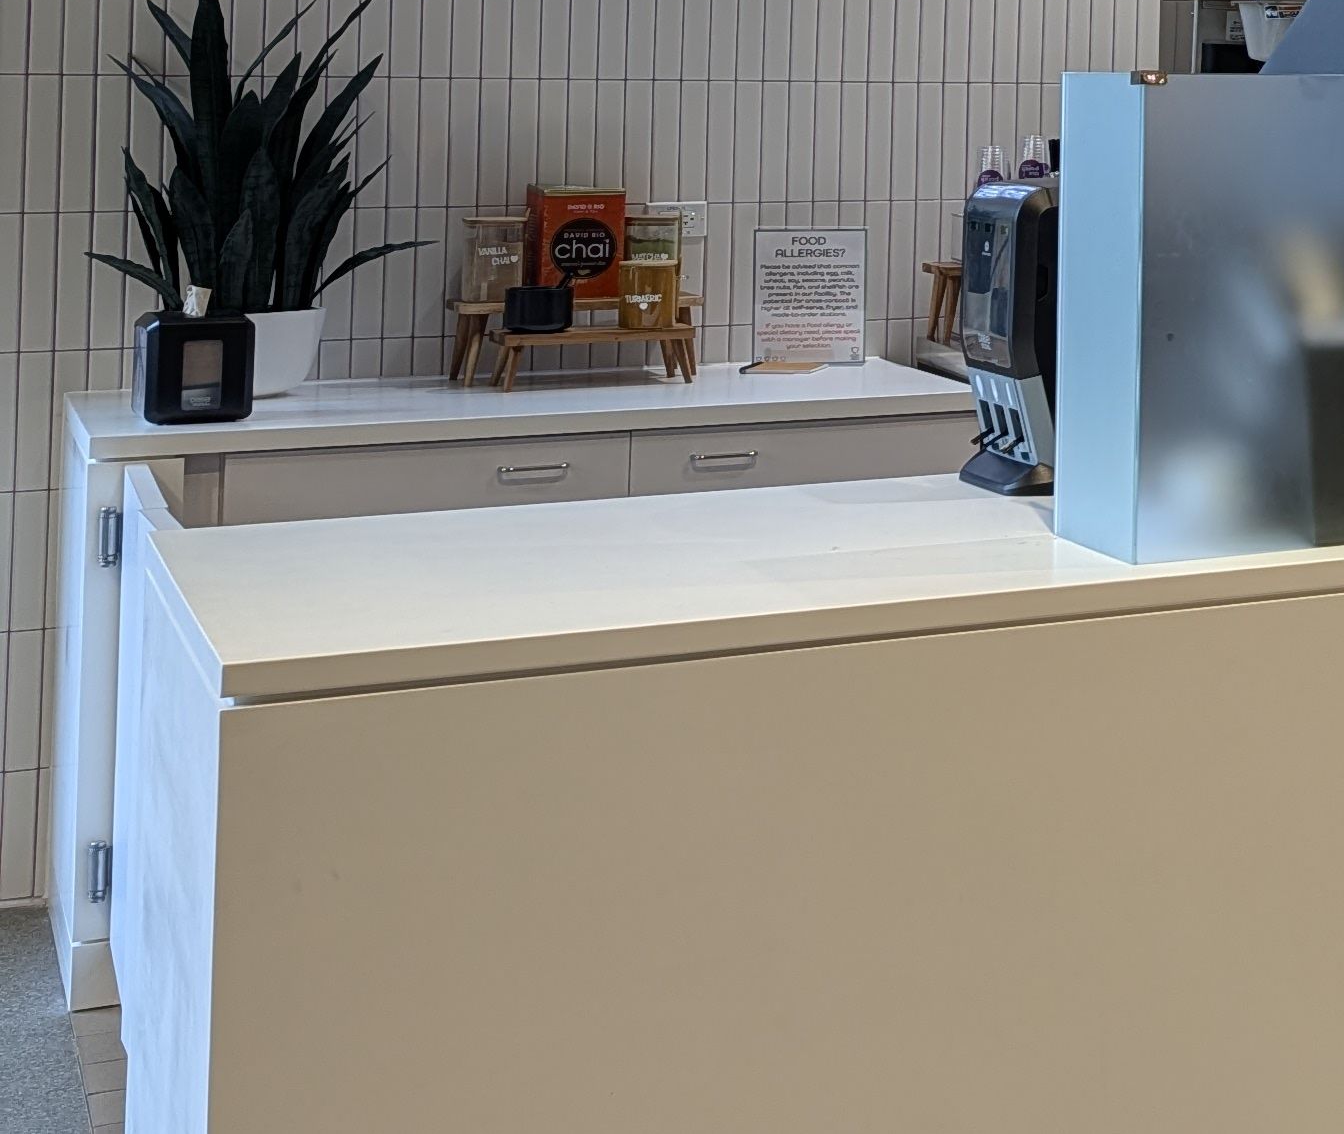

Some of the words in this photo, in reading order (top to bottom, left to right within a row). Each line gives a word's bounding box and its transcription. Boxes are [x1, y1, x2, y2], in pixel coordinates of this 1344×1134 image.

[792, 236, 826, 246] FOOD
[478, 246, 508, 256] VANILLA
[554, 238, 610, 259] chai
[775, 248, 846, 258] ALLERGIES?
[492, 256, 510, 266] CHAI
[625, 294, 662, 303] TURMERIC
